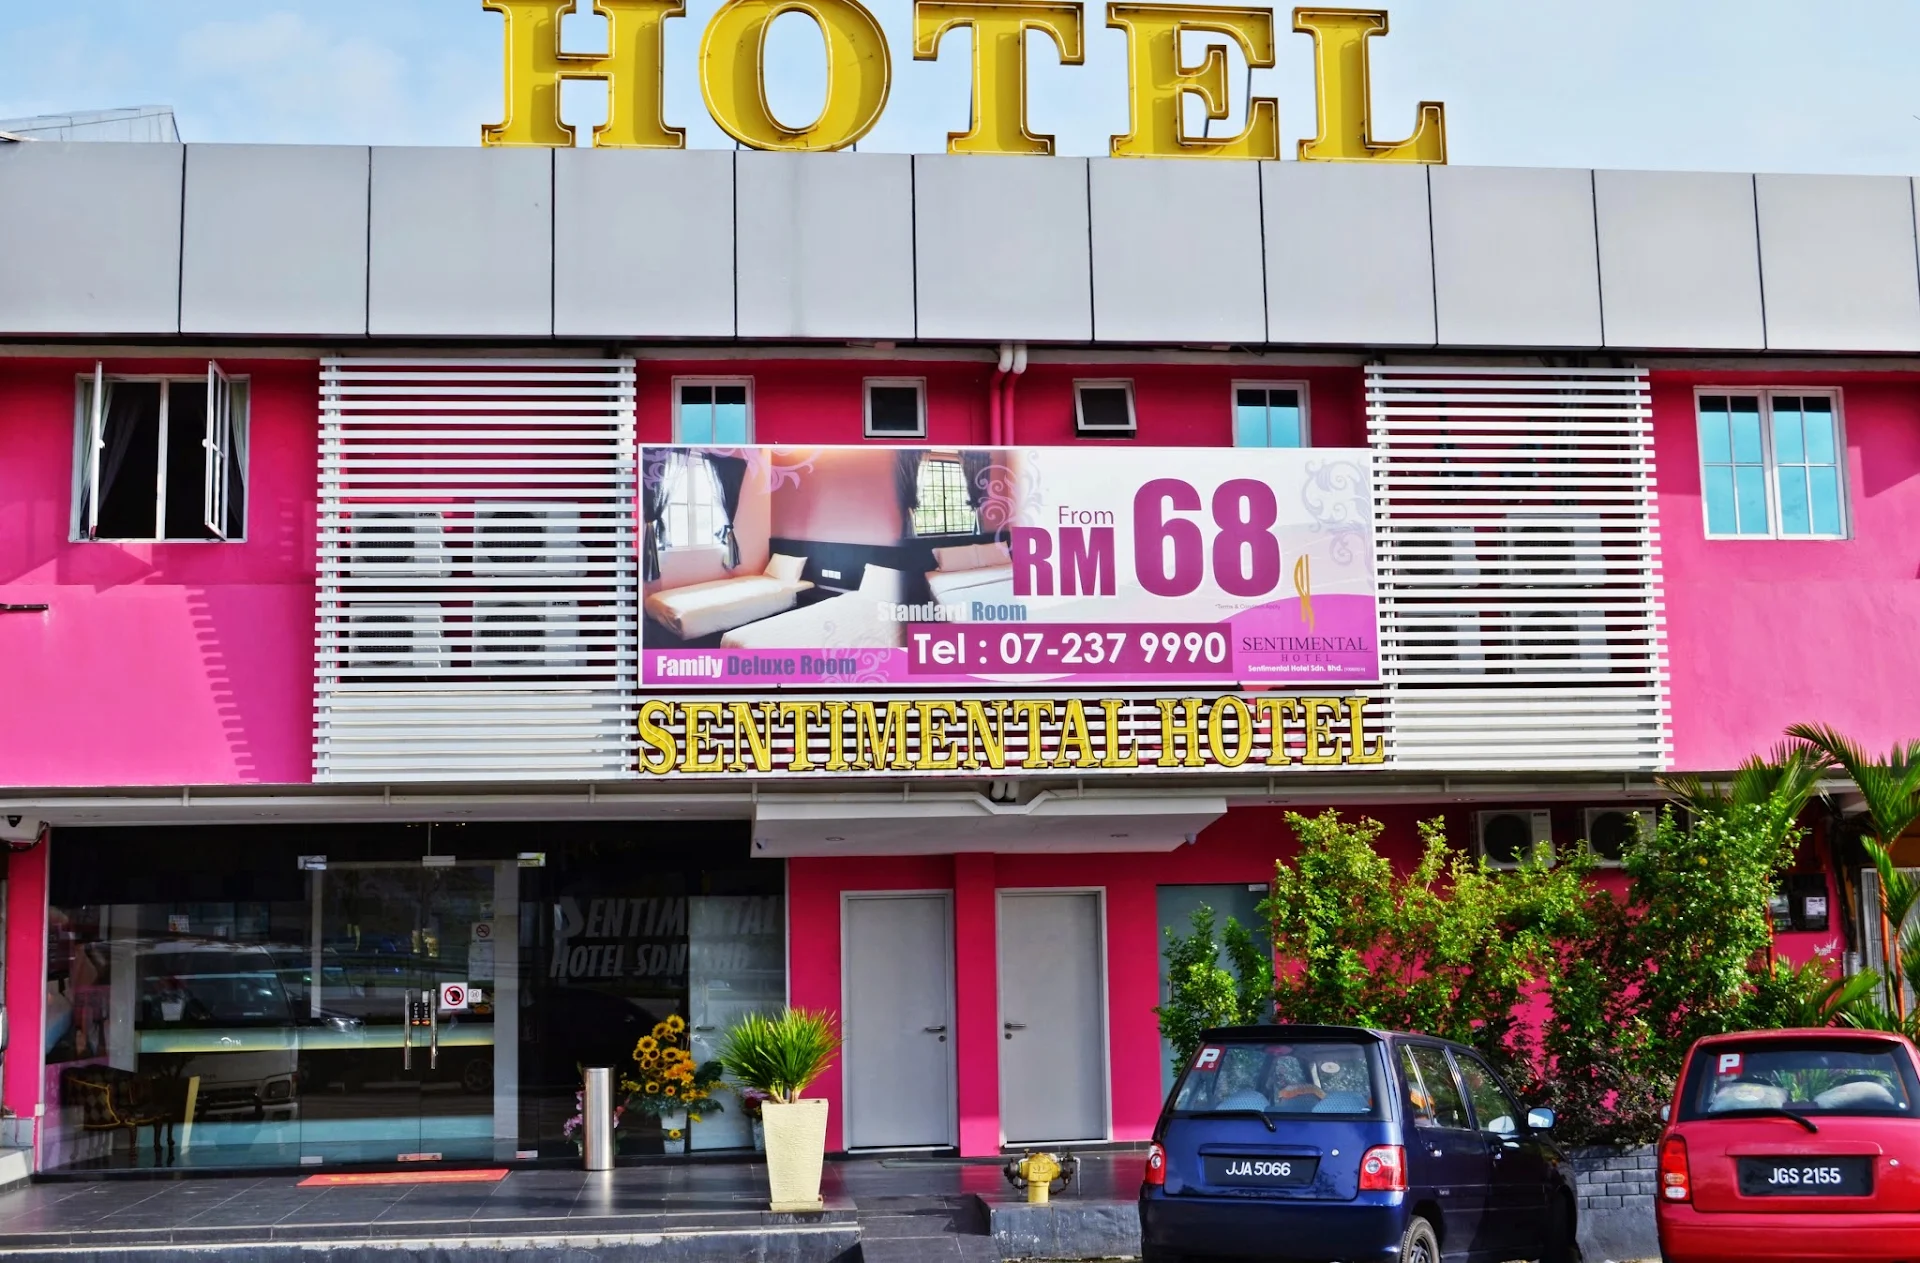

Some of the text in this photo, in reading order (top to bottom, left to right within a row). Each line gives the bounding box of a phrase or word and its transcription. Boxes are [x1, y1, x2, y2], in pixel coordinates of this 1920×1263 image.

[480, 0, 1447, 165] HOTEL
[1058, 505, 1114, 525] From
[1011, 477, 1281, 597] RM 68
[877, 601, 1028, 622] Standard Room
[914, 632, 966, 665] Tel
[998, 631, 1127, 665] 07-237
[1139, 631, 1227, 664] 9990
[1242, 637, 1368, 651] SENTIMENTAL
[656, 655, 857, 678] Family Deluxe Room
[1248, 664, 1290, 672] Sentimental
[1291, 664, 1310, 672] Hotel
[1311, 664, 1326, 672] Sdn.
[1327, 664, 1343, 672] Bhd.
[1281, 653, 1333, 662] HOTEL
[637, 694, 1384, 774] SENTIMENTAL HOTEL
[633, 943, 689, 977] SDN
[1195, 1047, 1221, 1069] P
[1718, 1053, 1741, 1073] P
[1225, 1161, 1292, 1176] JJA 5066
[1767, 1167, 1842, 1185] JGS 2155
